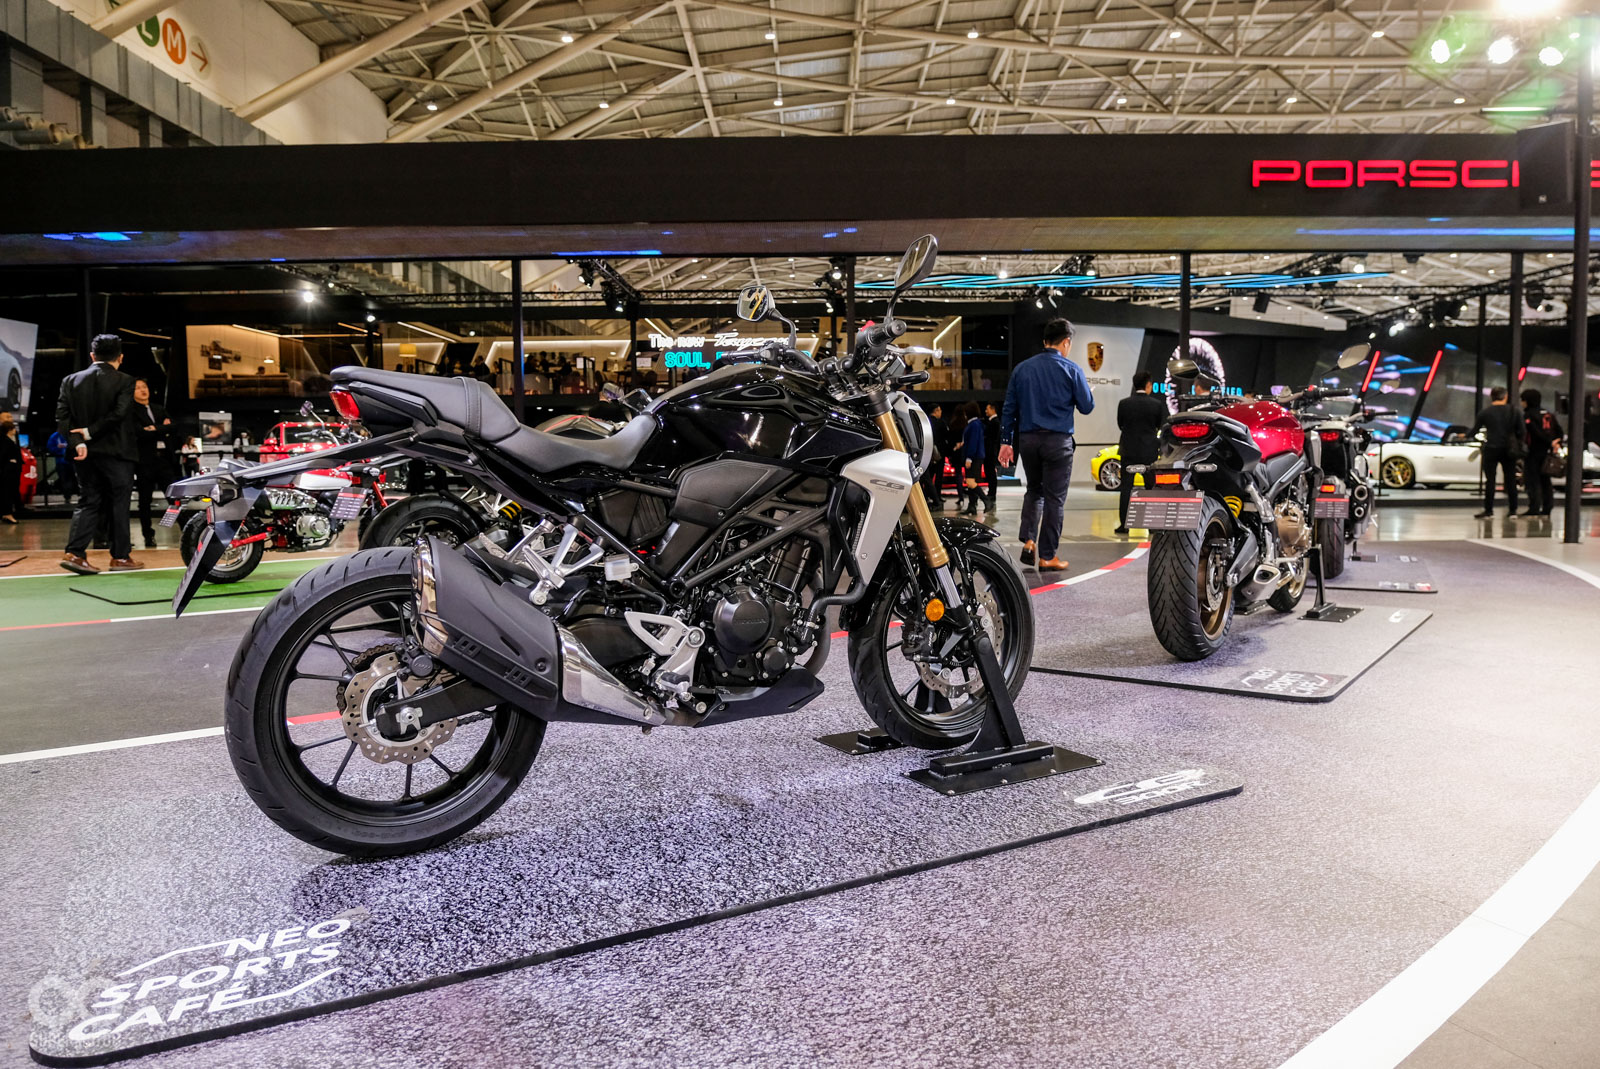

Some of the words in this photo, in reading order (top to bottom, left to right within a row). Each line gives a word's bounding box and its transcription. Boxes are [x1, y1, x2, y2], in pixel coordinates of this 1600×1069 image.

[166, 23, 182, 59] M
[1252, 159, 1600, 188] PORSC
[648, 333, 674, 348] The
[677, 336, 706, 348] new
[664, 351, 712, 370] SOUL,
[870, 479, 904, 491] CB
[223, 919, 350, 957] NEO
[91, 942, 342, 1008] SPORTS
[69, 982, 247, 1041] CAFÉ
